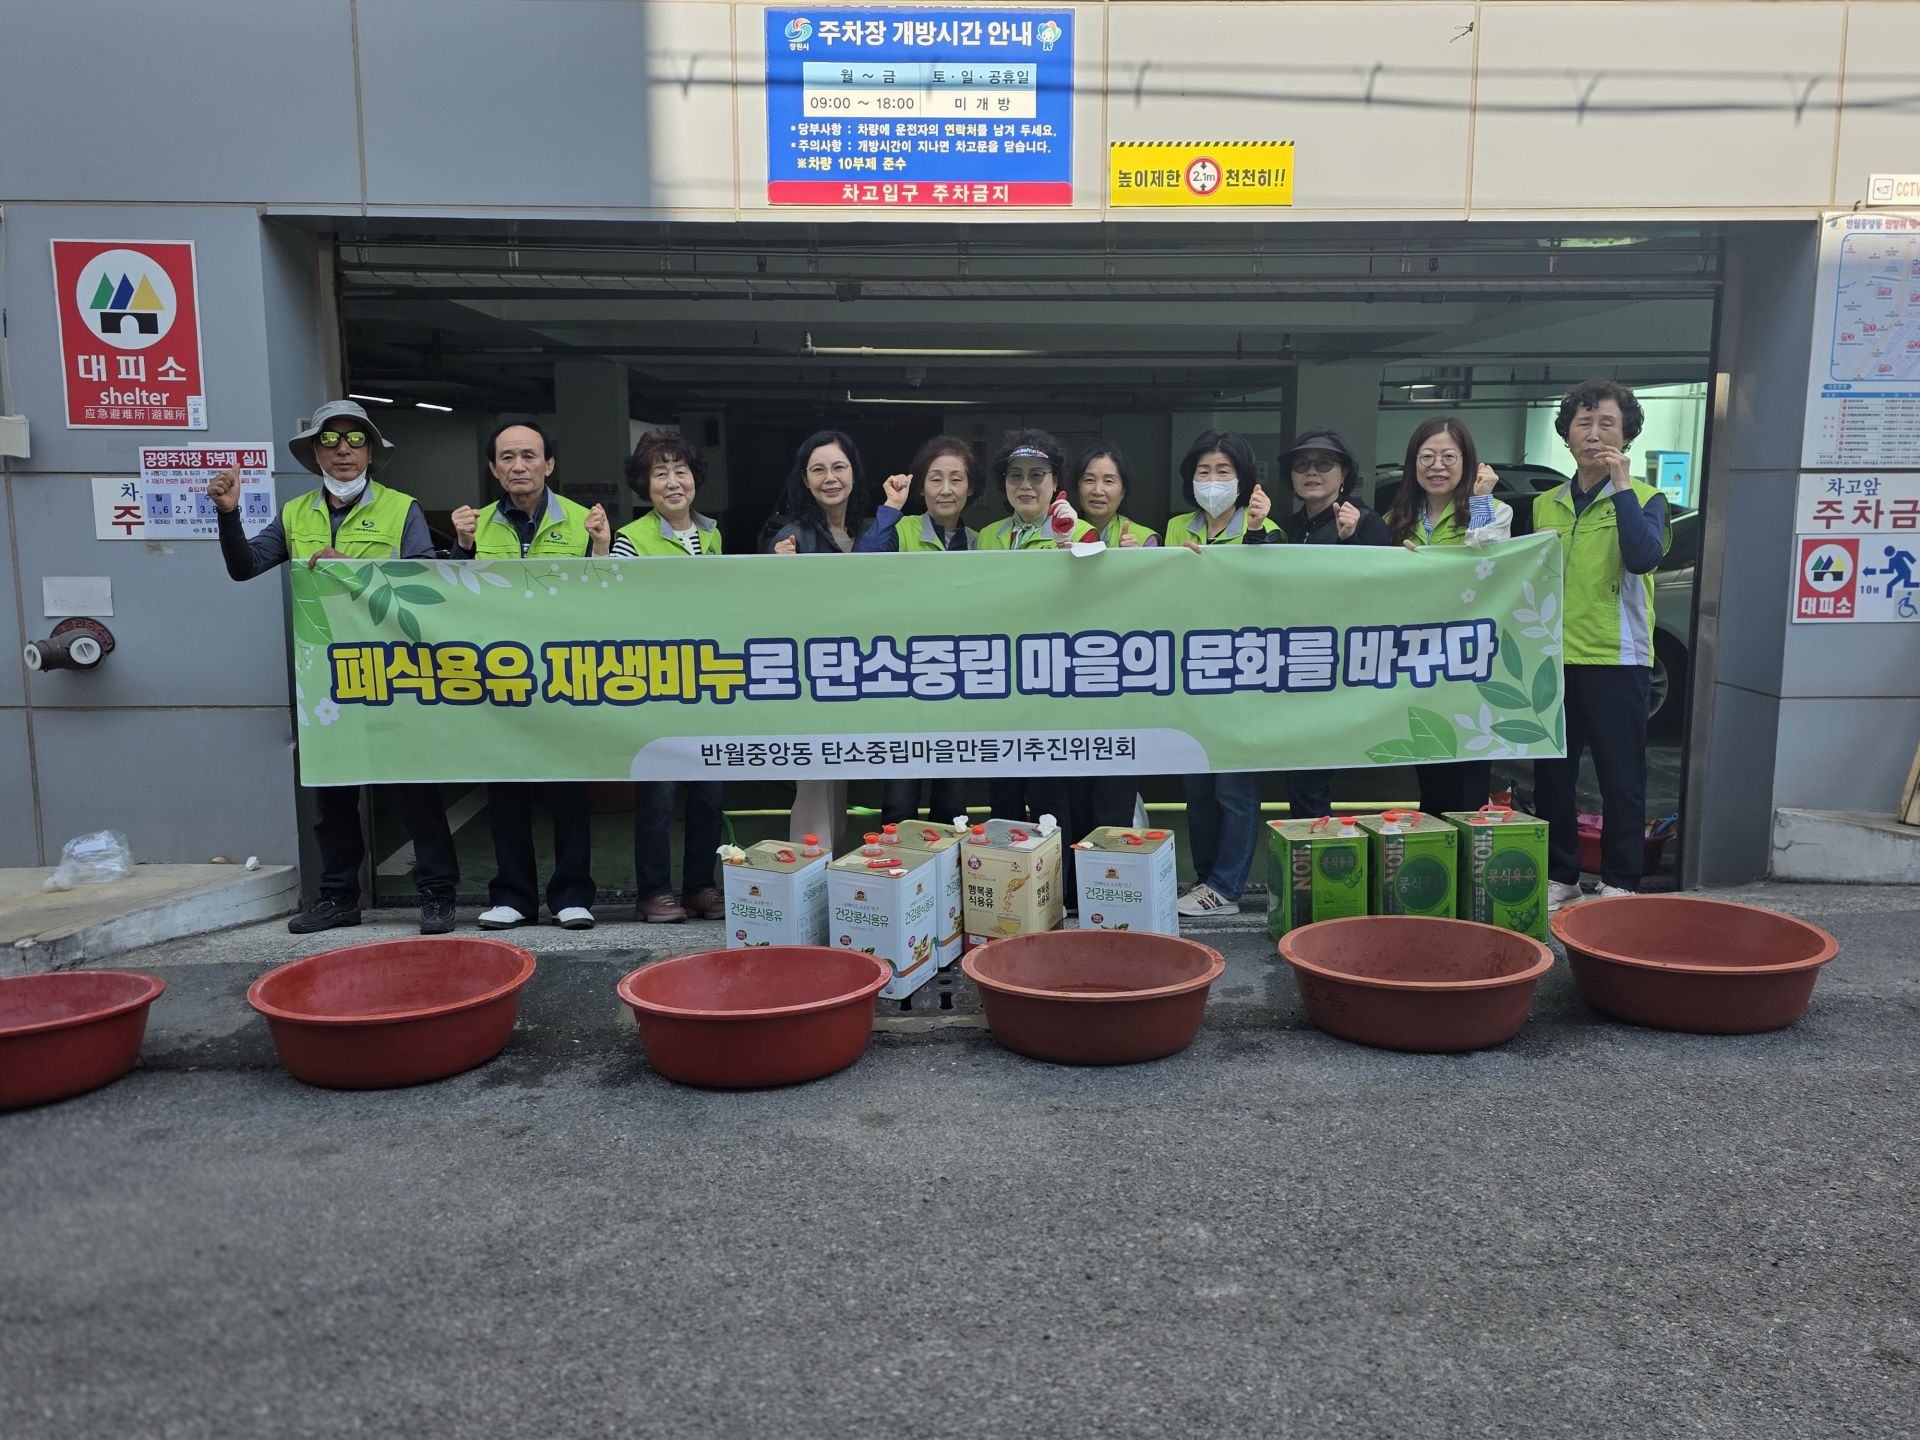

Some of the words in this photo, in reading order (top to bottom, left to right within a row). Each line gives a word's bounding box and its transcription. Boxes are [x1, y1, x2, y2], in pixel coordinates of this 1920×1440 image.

[818, 20, 887, 46] 주차장
[892, 20, 983, 46] 개방시간
[987, 20, 1032, 46] 안내
[789, 42, 809, 51] 창원시
[841, 69, 853, 84] 월
[882, 70, 896, 84] 금
[988, 70, 1029, 84] 공휴일
[810, 97, 851, 109] 09:00
[876, 97, 914, 110] 18:00
[798, 123, 842, 136] 당부사항
[858, 123, 890, 136] 차량에
[895, 123, 939, 136] 운전자의
[945, 124, 988, 136] 연락처를
[993, 124, 1015, 136] 남겨
[1020, 124, 1057, 137] 두세요.
[798, 140, 842, 152] 주의사항
[858, 140, 911, 152] 개방시간이
[918, 140, 949, 153] 지나면
[955, 140, 998, 153] 차고문을
[1004, 140, 1051, 153] 닫습니다.
[838, 157, 877, 171] 10부제
[882, 157, 907, 171] 준수
[1118, 169, 1181, 188] 높이제한
[1192, 171, 1216, 182] 2.1m
[1226, 169, 1286, 187] 천천히!!
[842, 184, 919, 202] 차고입구
[932, 184, 1009, 203] 주차금지
[78, 355, 187, 382] 대피소
[100, 387, 170, 406] shelter
[145, 452, 202, 467] 공영주차장
[206, 452, 238, 466] 5부제
[242, 451, 266, 466] 실시
[1826, 477, 1882, 497] 차고앞
[1812, 498, 1920, 530] 주차금
[1801, 597, 1852, 615] 대피소
[331, 643, 534, 703] 폐식용유
[545, 642, 797, 701] 재생비누로
[808, 638, 1007, 698] 탄소중립
[1020, 633, 1172, 693] 마을의
[1185, 629, 1335, 691] 문화를
[1347, 622, 1496, 685] 바꾸다
[700, 741, 813, 768] 반월중앙동
[821, 735, 1137, 766] 탄소중립마을만들기추진위원회
[1487, 867, 1537, 886] 콩식용유
[968, 884, 994, 898] 행복콩
[1085, 887, 1144, 903] 건강콩식용유
[905, 896, 935, 926] 건강콩식용유
[968, 896, 994, 909] 식용유
[731, 902, 783, 922] 건강콩식용유
[835, 907, 889, 928] 건강콩식용유
